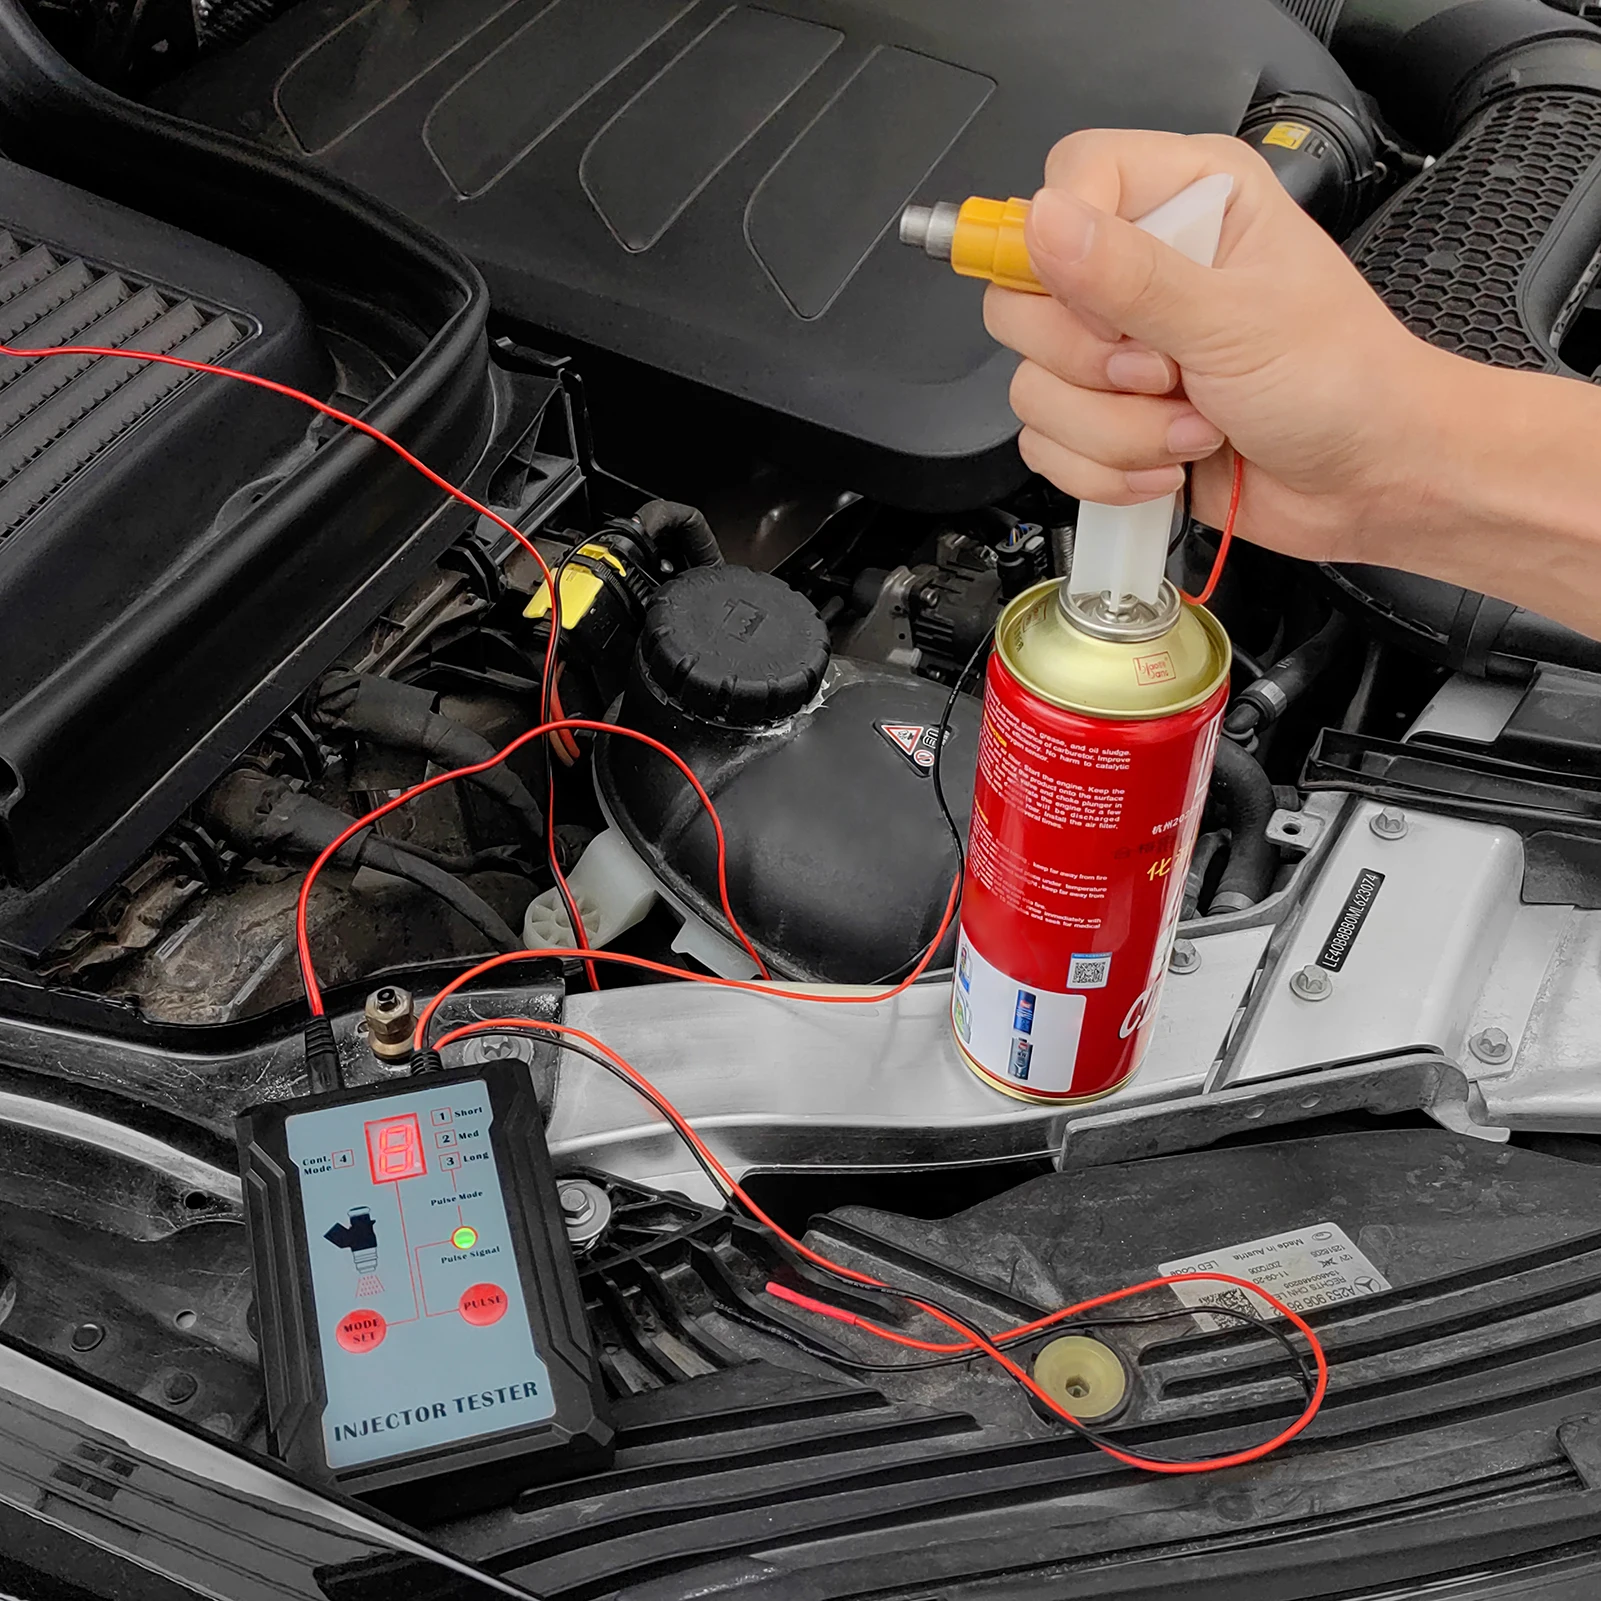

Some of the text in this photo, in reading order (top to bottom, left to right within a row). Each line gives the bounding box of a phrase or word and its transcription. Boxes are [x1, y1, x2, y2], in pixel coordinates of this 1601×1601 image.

[1052, 745, 1095, 760] carburetor.
[1097, 755, 1131, 763] Improve
[1070, 744, 1086, 752] and
[1102, 749, 1131, 757] sludge.
[1046, 749, 1057, 758] No
[1059, 754, 1081, 765] harm
[1095, 763, 1130, 771] catalytic
[1030, 776, 1057, 792] product
[1058, 788, 1077, 797] onto
[1078, 792, 1092, 800] the
[1042, 773, 1054, 783] the
[1056, 780, 1085, 792] engine.
[1088, 786, 1109, 795] Keep
[1039, 788, 1054, 797] and
[1055, 795, 1079, 805] choke
[1081, 800, 1113, 809] plunger
[1041, 796, 1053, 804] the
[1055, 801, 1082, 812] engine
[1043, 811, 1067, 823] Install
[1069, 819, 1082, 827] the
[1054, 808, 1066, 816] be
[1070, 812, 1120, 823] discharged
[1042, 878, 1062, 887] under
[1065, 883, 1108, 892] temperature
[454, 1106, 483, 1118] Short
[458, 1129, 480, 1141] Med
[377, 1123, 415, 1176] 8
[463, 1151, 490, 1163] Long
[302, 1156, 331, 1167] Cont.
[304, 1165, 332, 1176] Mode
[430, 1190, 484, 1207] Pulse Mode
[1277, 1239, 1304, 1249] Made
[441, 1245, 501, 1265] Pulse Signal
[1233, 1248, 1265, 1261] Austria
[1303, 1294, 1327, 1307] 906
[1325, 1285, 1356, 1301] A253
[463, 1295, 503, 1311] PULSE
[343, 1317, 380, 1333] MODE
[352, 1331, 376, 1345] SET
[334, 1380, 540, 1443] INJECTOR TESTER
